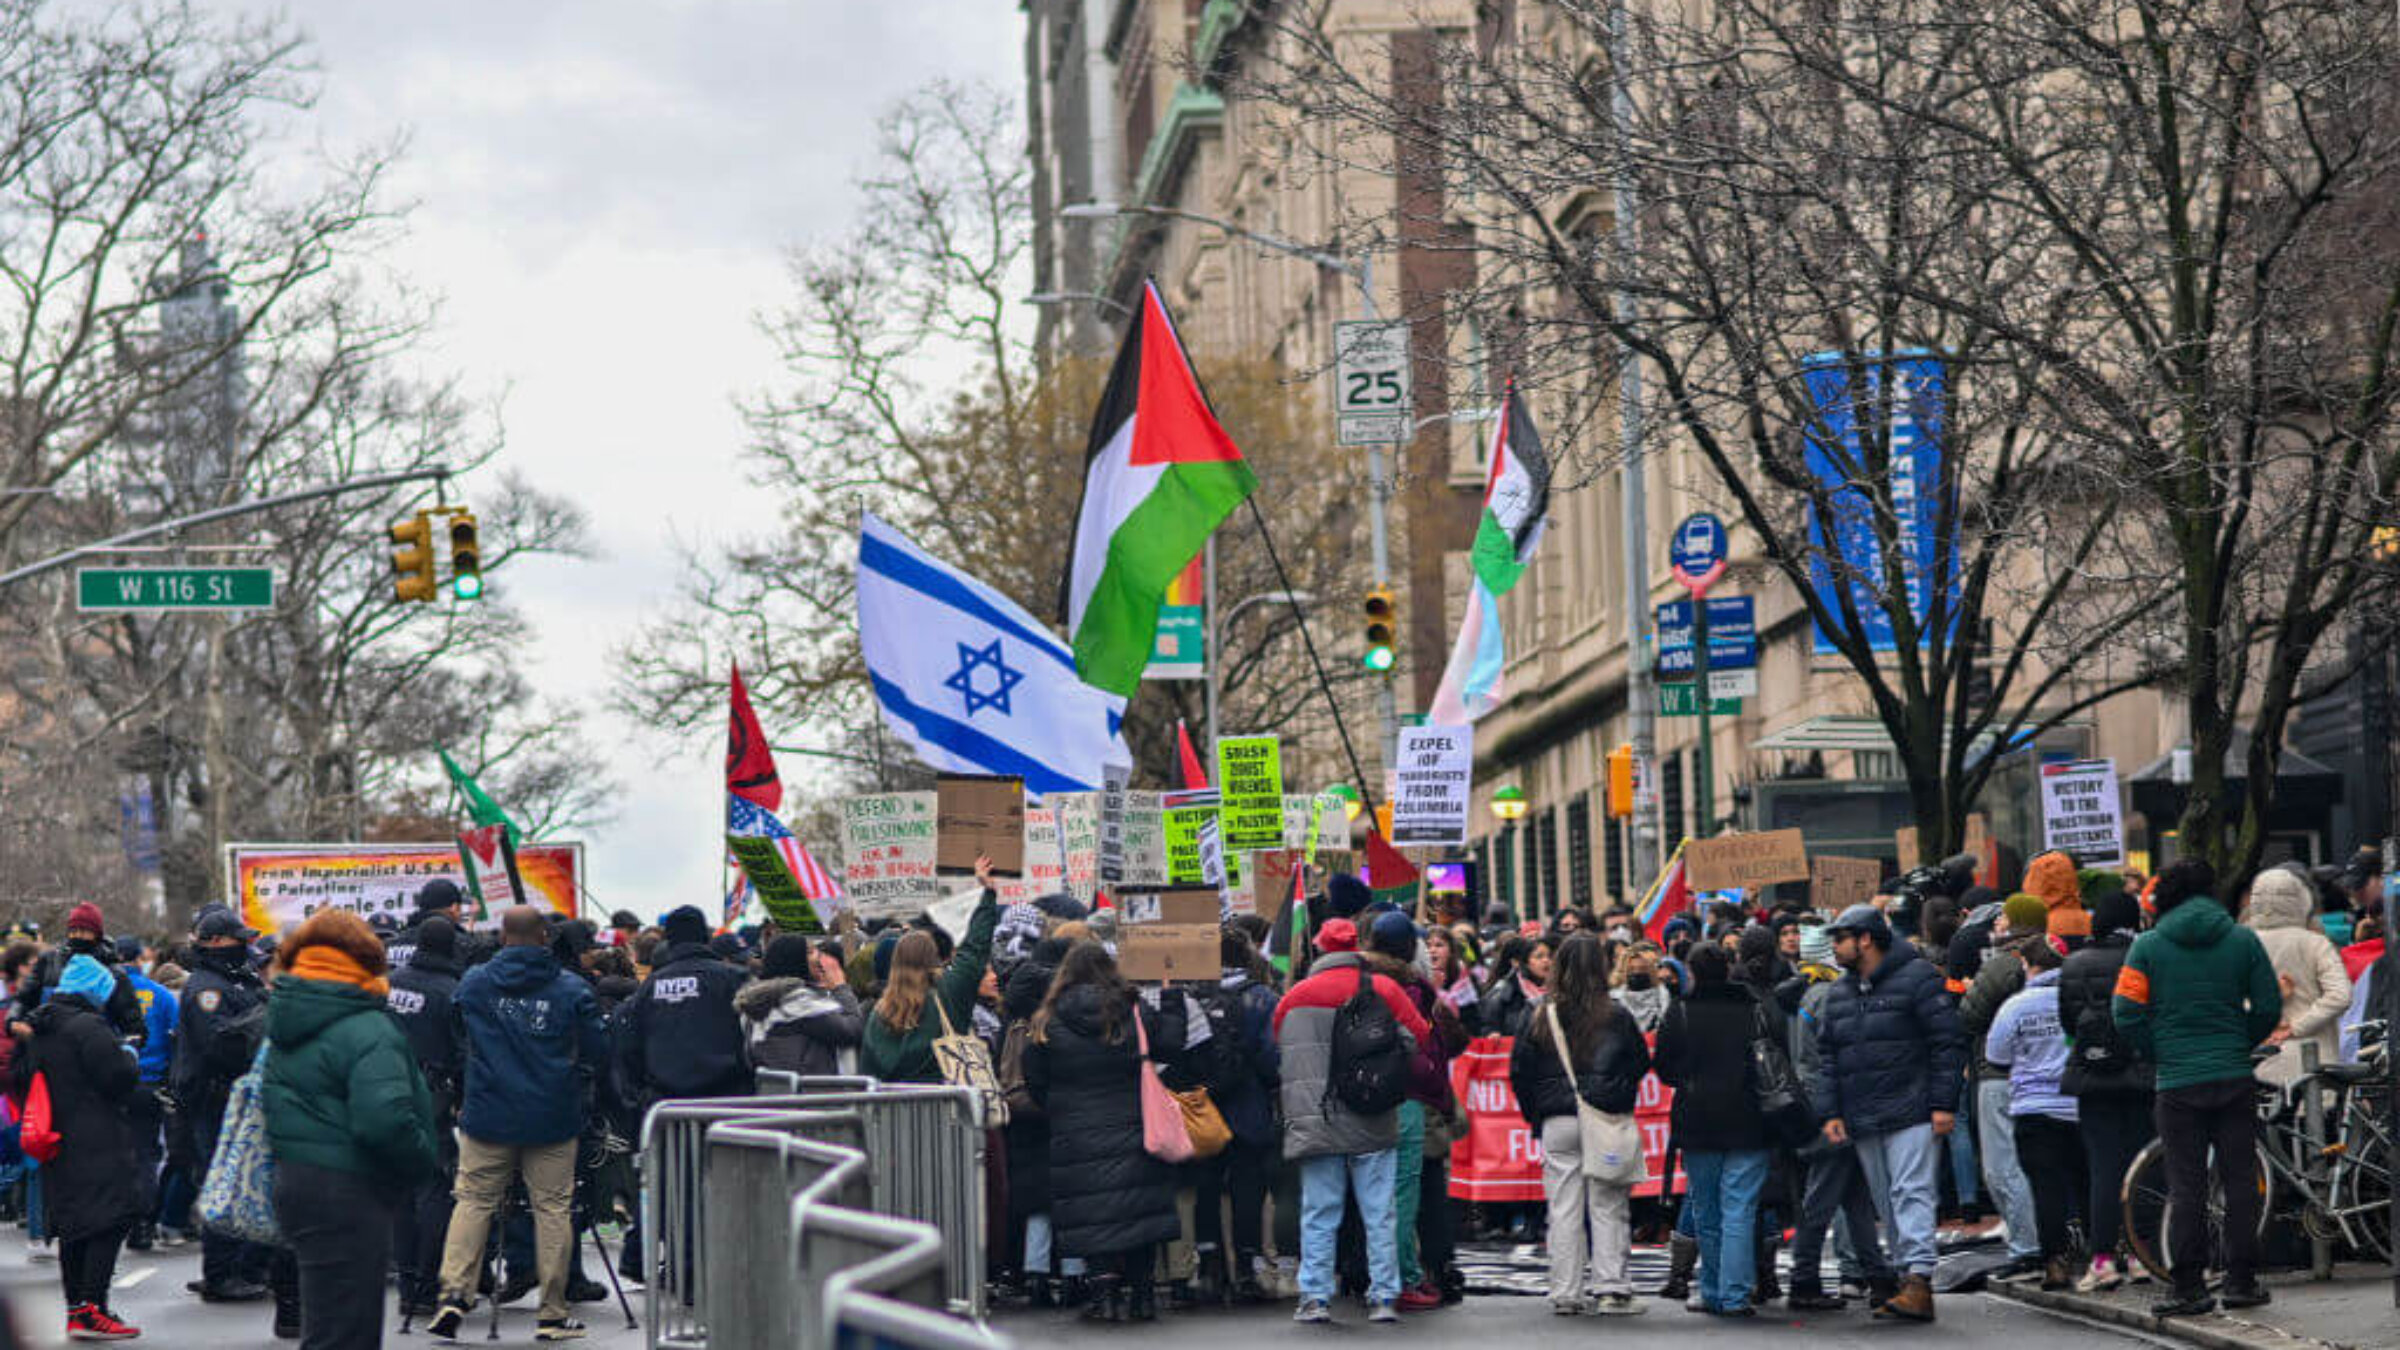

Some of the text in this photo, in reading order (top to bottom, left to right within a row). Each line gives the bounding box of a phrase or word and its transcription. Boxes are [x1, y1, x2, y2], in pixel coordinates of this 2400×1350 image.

[1347, 371, 1402, 404] 25
[119, 576, 233, 601] W 116 St
[1663, 687, 1680, 712] W
[1410, 738, 1455, 751] EXPEL
[1406, 785, 1449, 798] FROM
[302, 863, 397, 881] Imperialist
[654, 976, 698, 998] NYPD
